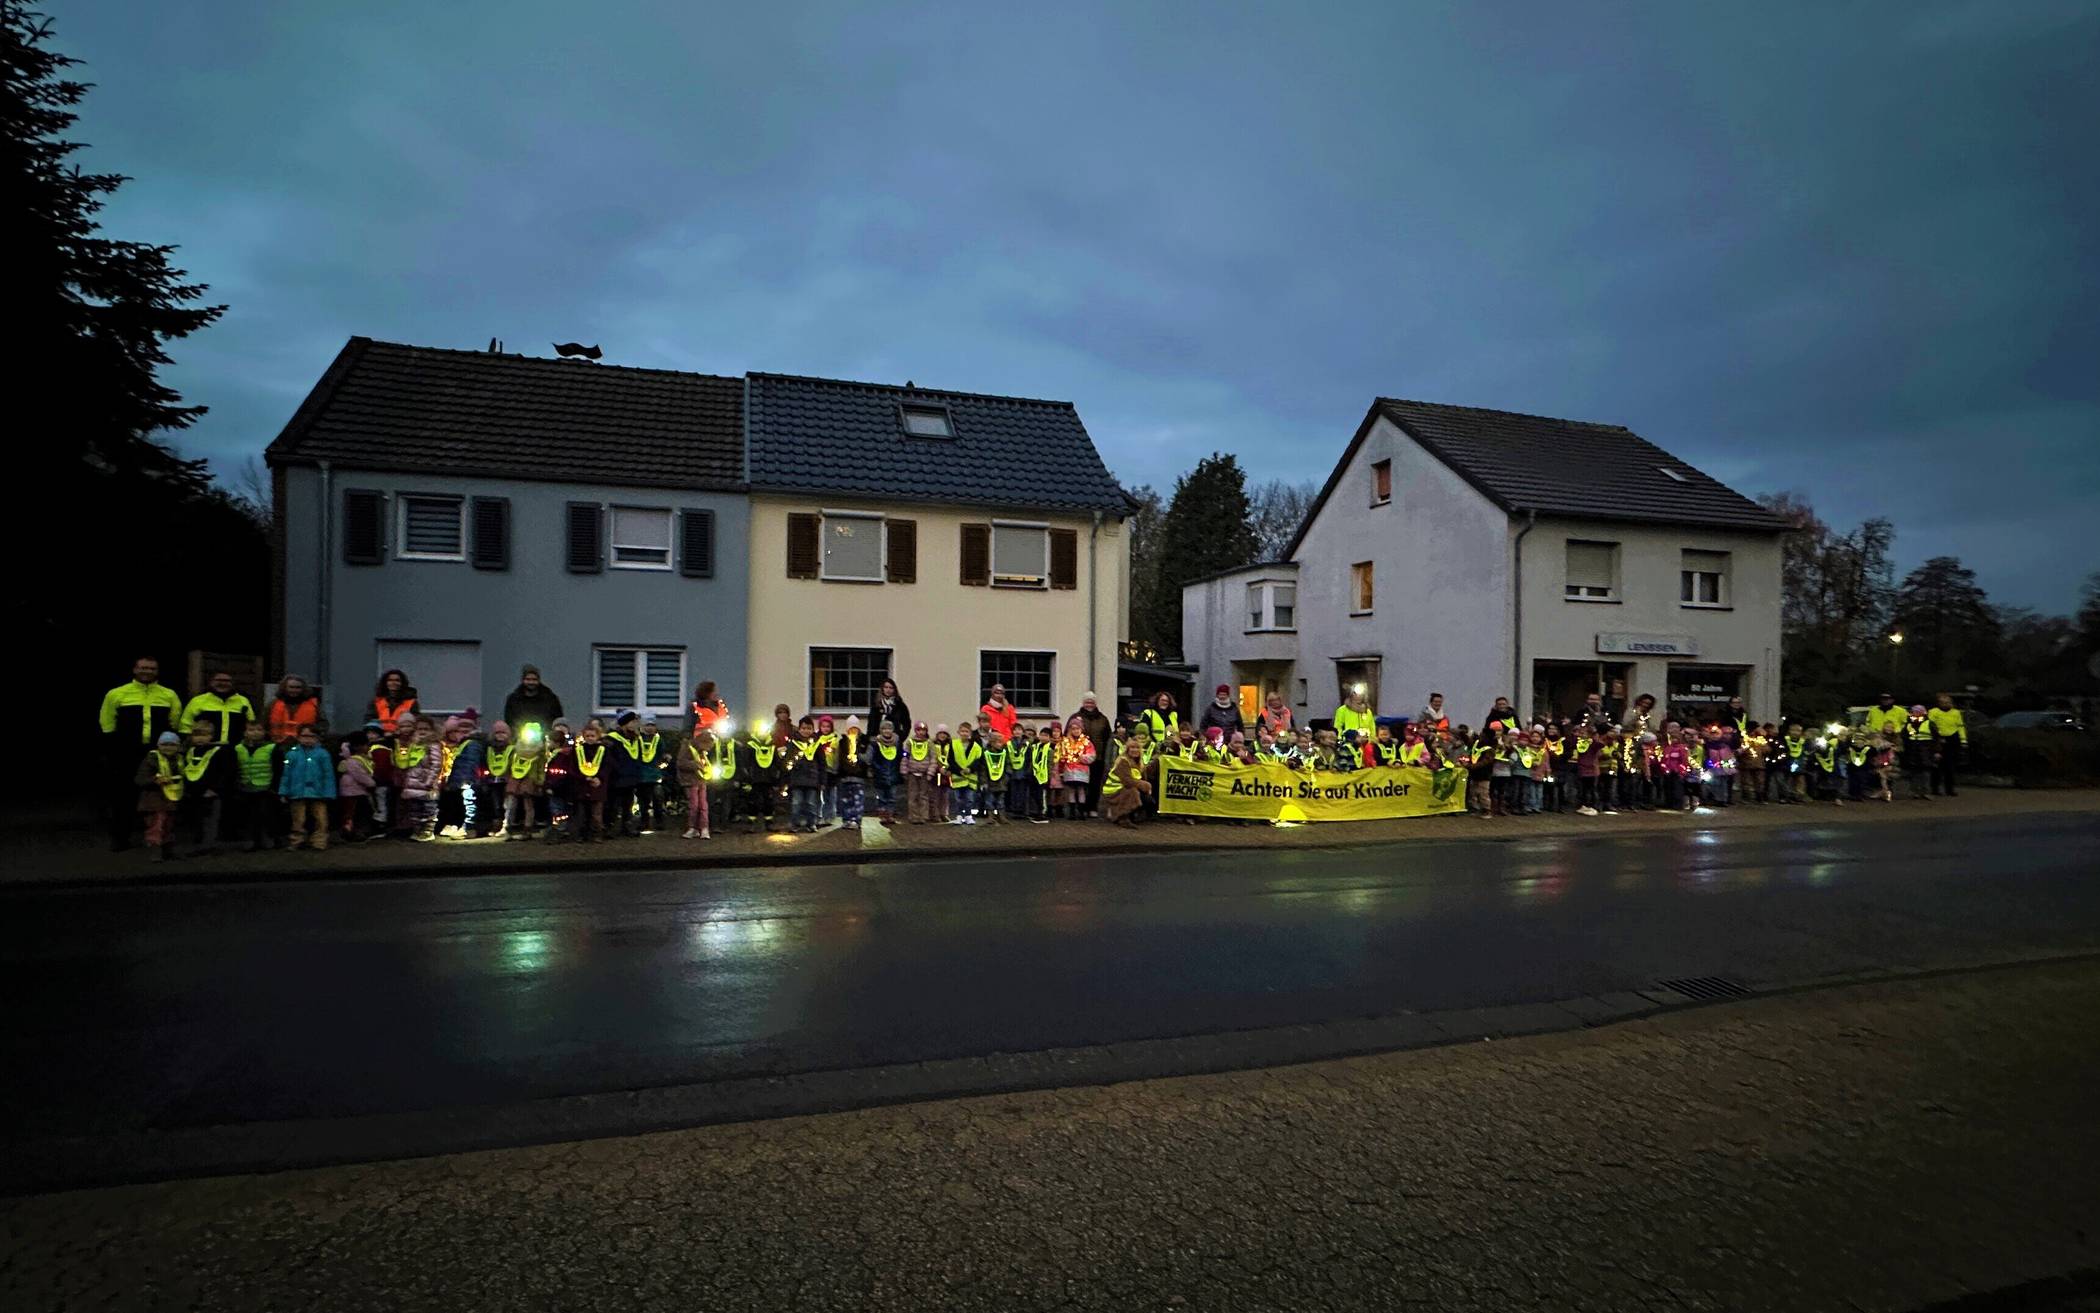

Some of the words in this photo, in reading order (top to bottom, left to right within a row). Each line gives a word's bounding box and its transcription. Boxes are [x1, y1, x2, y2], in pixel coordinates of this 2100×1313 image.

[1628, 643, 1677, 652] LENSSEN
[1168, 773, 1214, 787] VERKEHRS
[1166, 785, 1198, 795] WACHT
[1231, 777, 1293, 798] Achten
[1298, 781, 1321, 799] Sie
[1325, 784, 1350, 799] auf
[1354, 780, 1410, 799] Kinder
